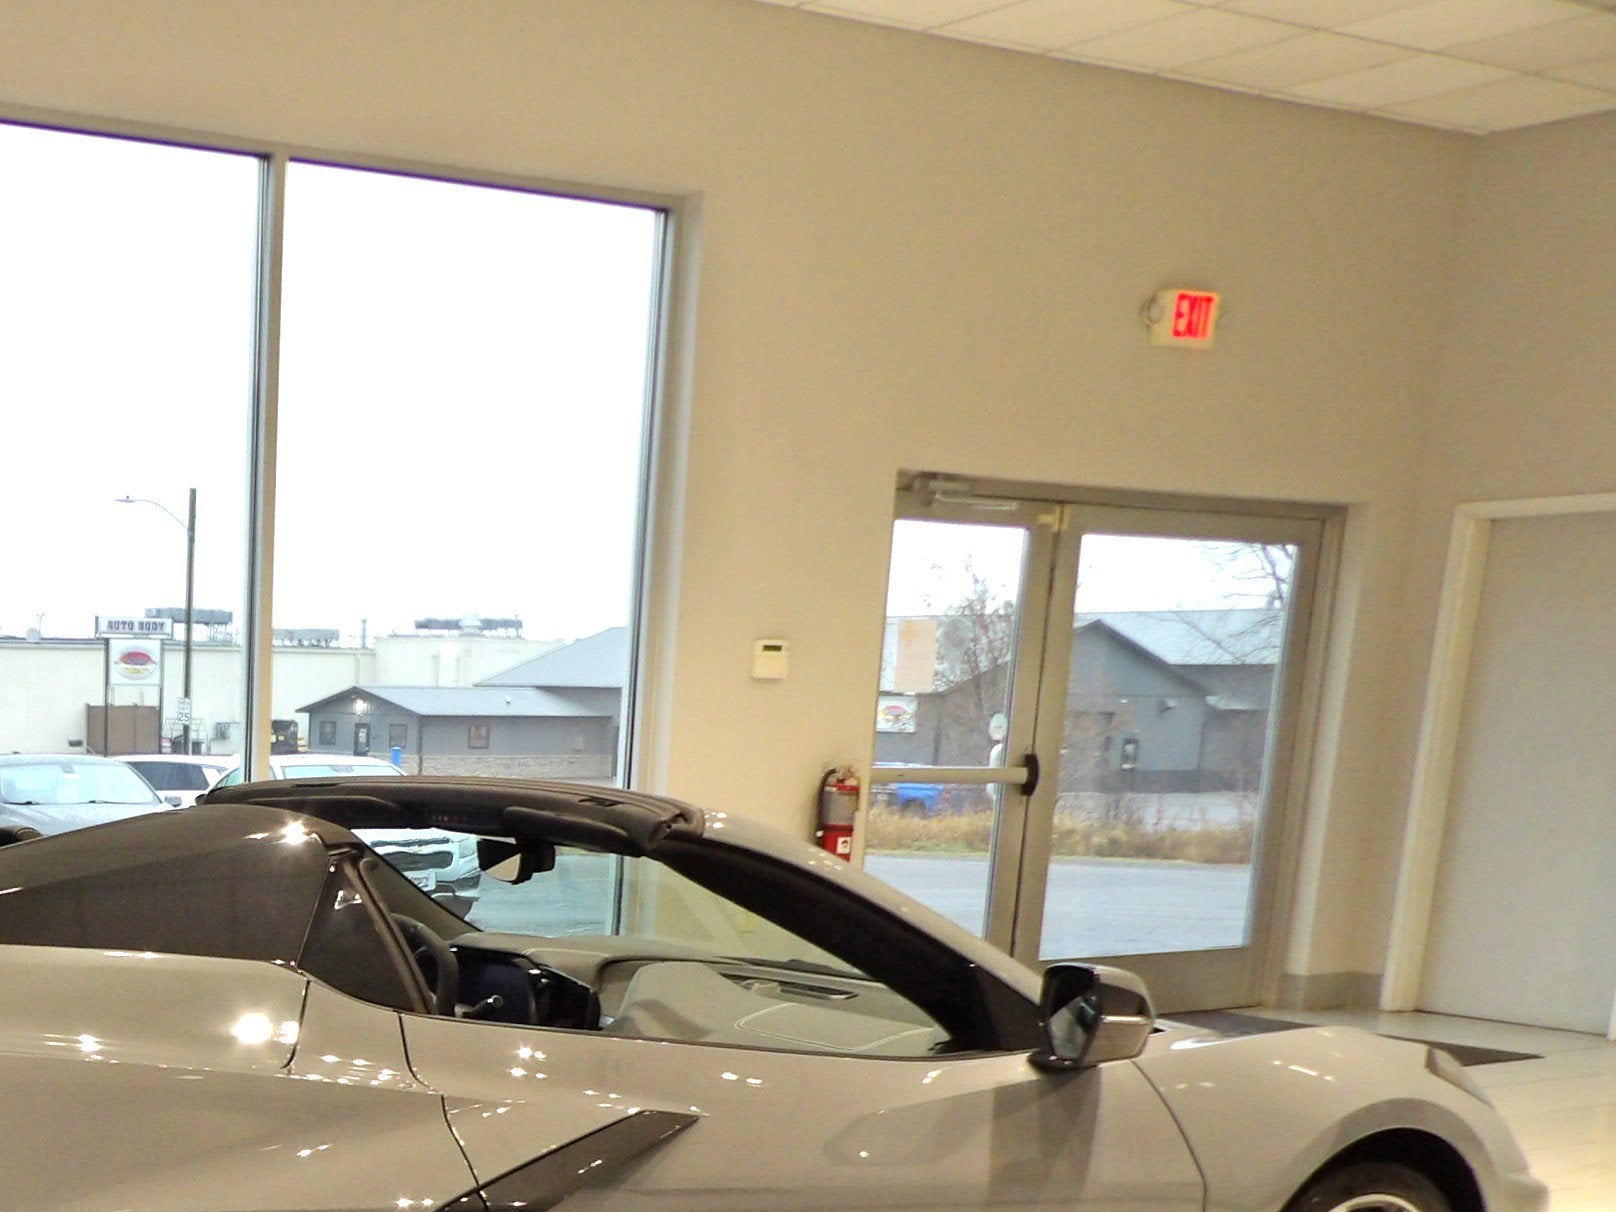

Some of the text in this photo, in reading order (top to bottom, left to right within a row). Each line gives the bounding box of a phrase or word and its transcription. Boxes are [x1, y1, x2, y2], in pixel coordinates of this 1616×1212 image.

[1173, 293, 1213, 338] EXIT
[107, 620, 165, 631] AUTO BODY
[178, 711, 189, 721] 25
